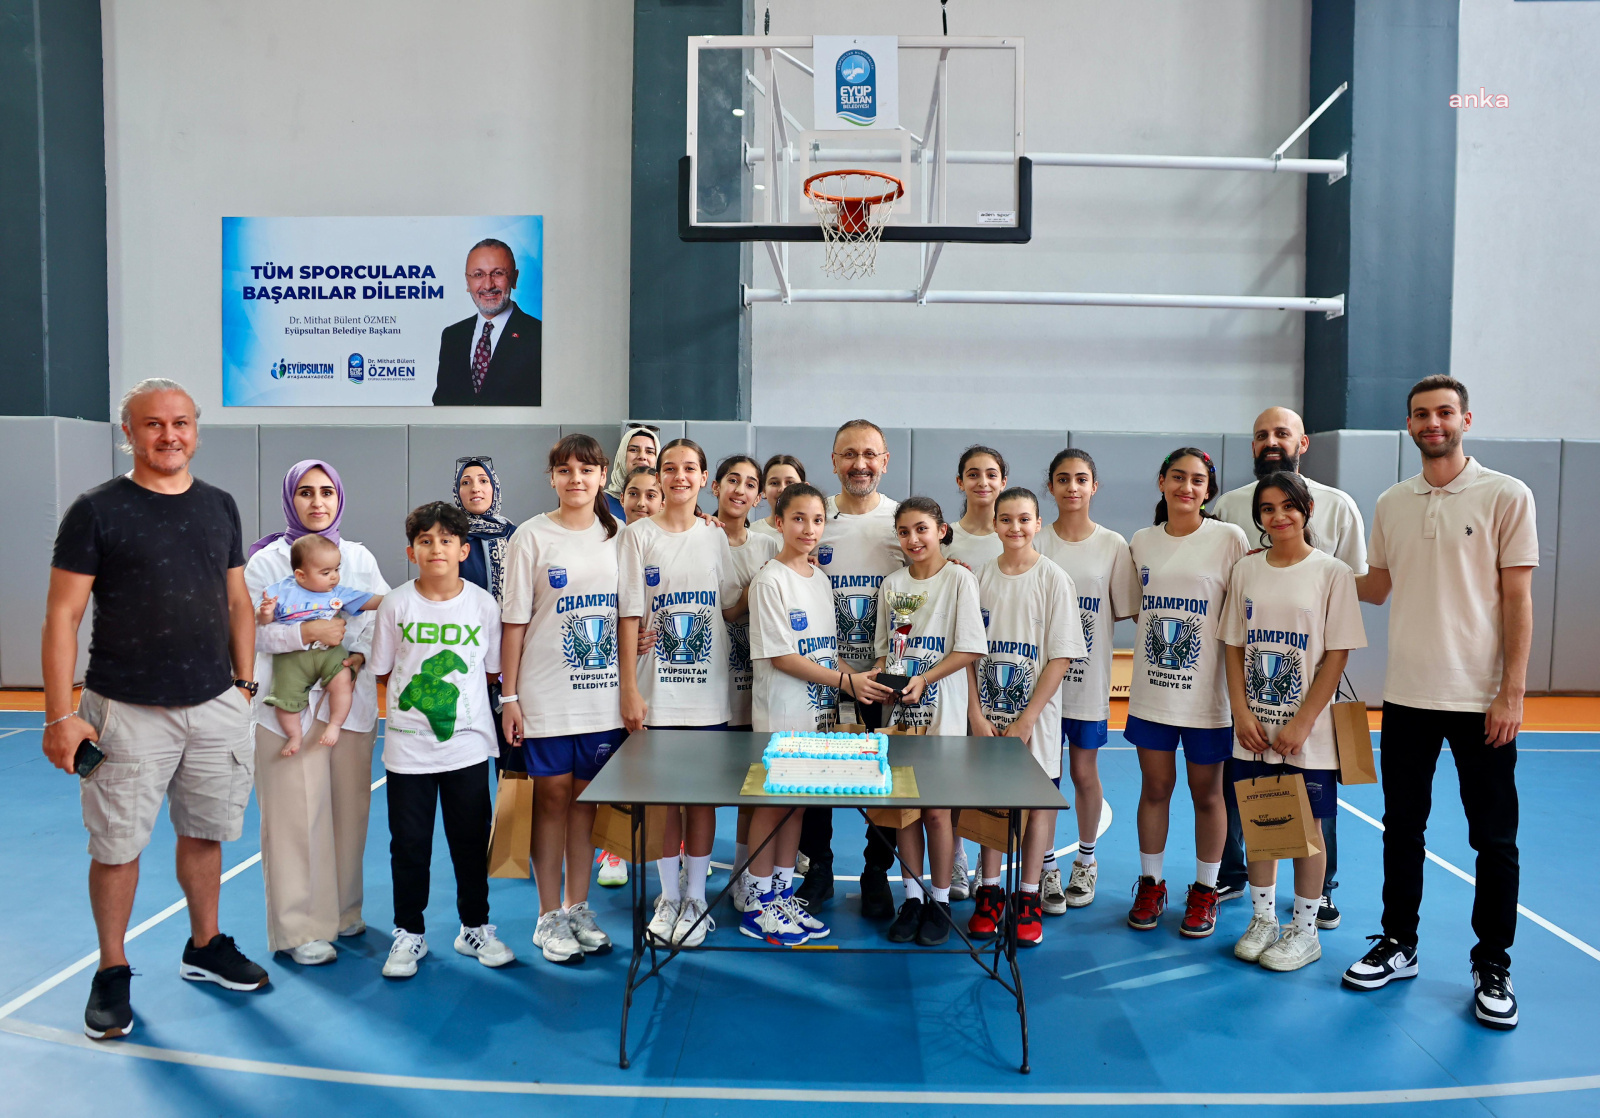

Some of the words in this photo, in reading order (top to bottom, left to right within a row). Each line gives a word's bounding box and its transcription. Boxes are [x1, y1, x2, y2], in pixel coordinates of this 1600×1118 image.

[840, 85, 872, 96] EYÜP
[840, 95, 872, 104] SULTAN
[250, 262, 294, 280] TÜM
[299, 265, 436, 280] SPORCULARA
[243, 286, 356, 304] BAŞARILAR
[362, 280, 444, 299] DİLERİM
[289, 316, 301, 324] Dr.
[304, 316, 331, 324] Mithat
[334, 316, 361, 324] Bülent
[363, 315, 397, 324] ÖZMEN
[284, 327, 330, 336] Eyüpsultan
[332, 327, 366, 336] Belediye
[369, 326, 401, 336] Başkanı
[287, 362, 334, 375] EYÜPSULTAN
[368, 364, 415, 377] ÖZMEN
[827, 575, 886, 589] HAMPIO
[652, 591, 716, 613] CHAMPION
[1142, 595, 1208, 616] CHAMPION
[397, 622, 482, 646] XBOX
[1247, 629, 1309, 651] HAMPION
[570, 672, 617, 681] EYÜPSULTAN
[658, 666, 708, 675] EYÜPSULTAN
[573, 680, 608, 690] BELEDİYE
[660, 675, 696, 684] BELEDİYE
